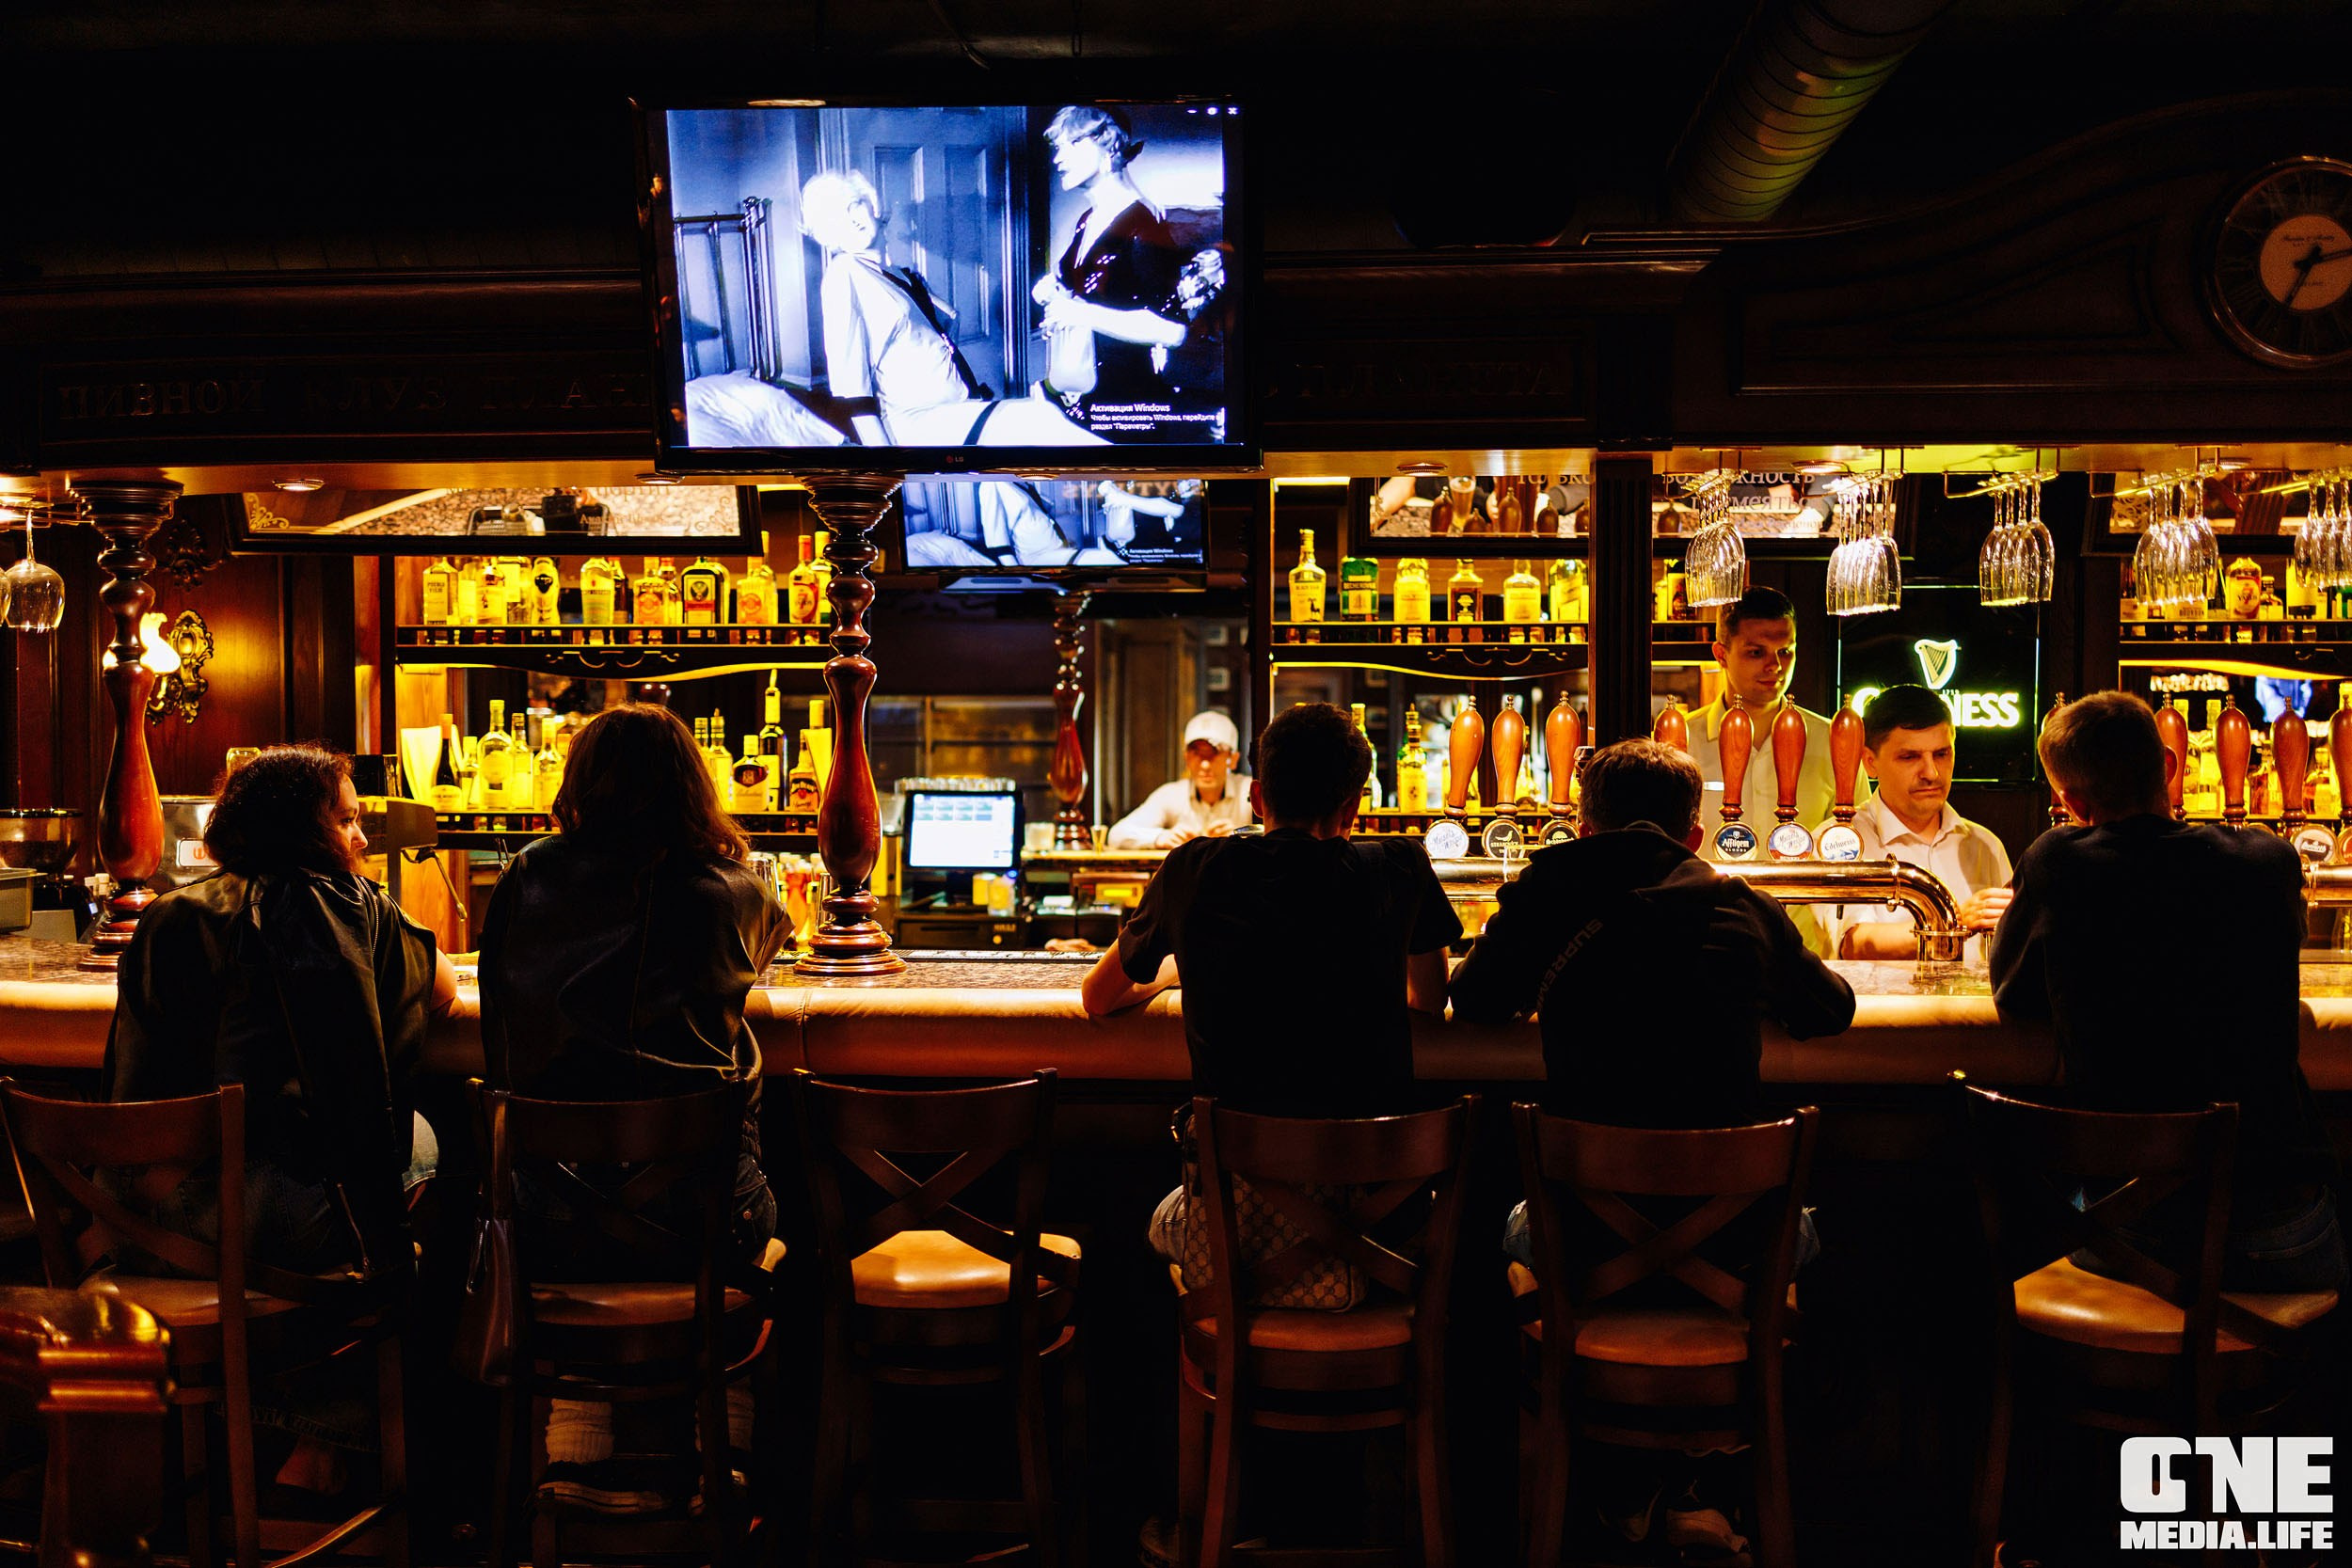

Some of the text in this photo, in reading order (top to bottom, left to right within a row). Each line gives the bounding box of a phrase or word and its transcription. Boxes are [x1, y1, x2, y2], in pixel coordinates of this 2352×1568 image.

[1090, 403, 1170, 413] Активация Windows
[1851, 688, 2020, 728] GNESS
